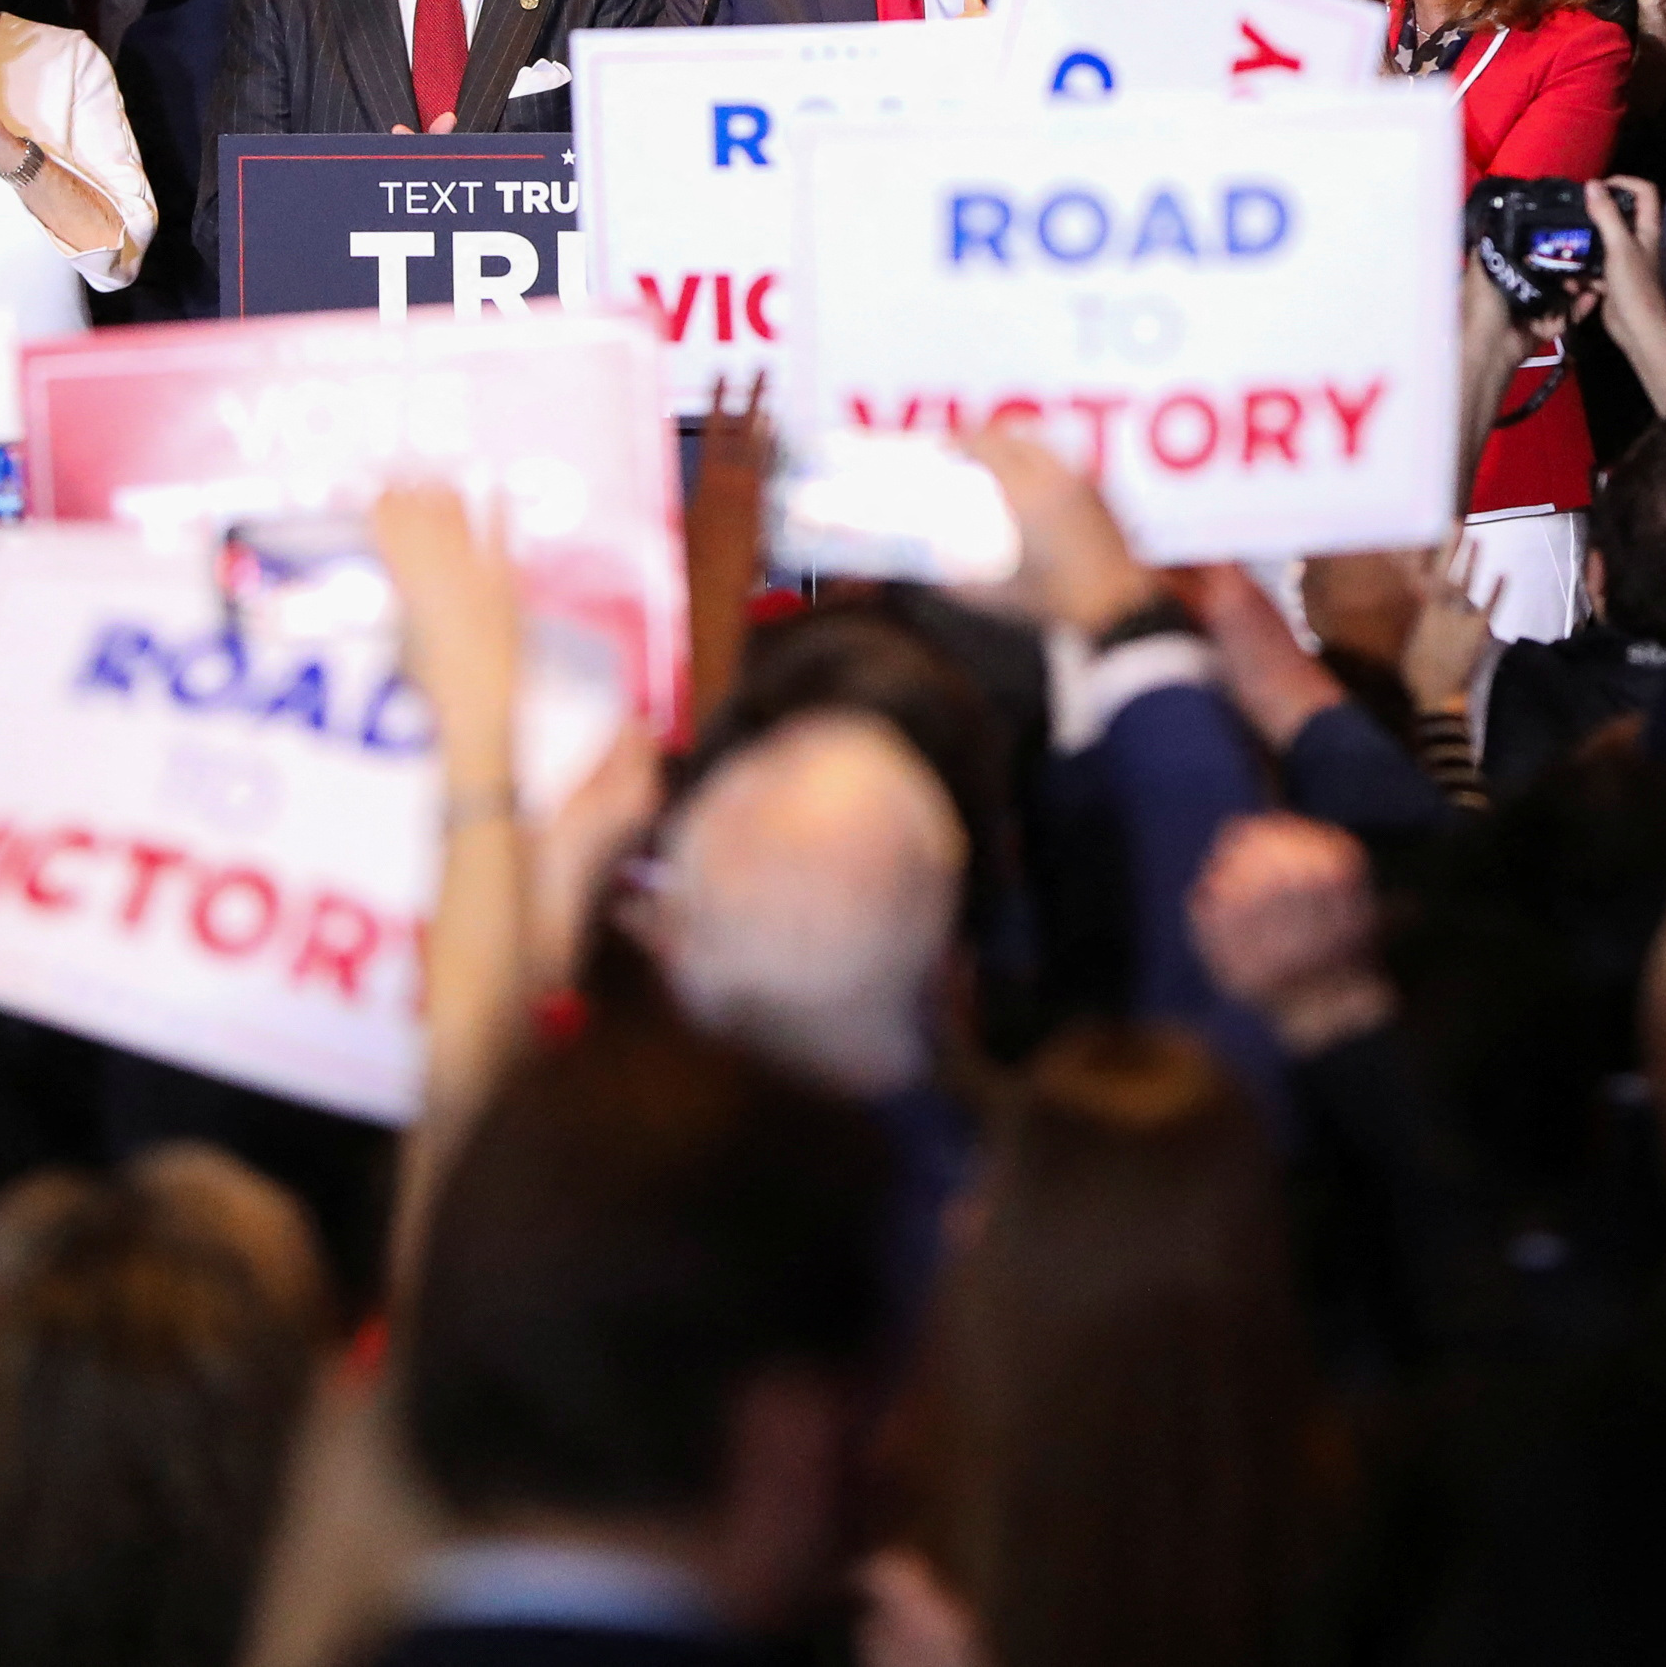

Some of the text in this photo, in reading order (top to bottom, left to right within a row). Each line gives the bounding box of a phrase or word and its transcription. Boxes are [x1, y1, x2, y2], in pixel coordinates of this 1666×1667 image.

[378, 181, 483, 214] TEXT
[941, 182, 1298, 272] ROAD
[1480, 235, 1543, 303] SONY
[71, 616, 442, 756] ROAD
